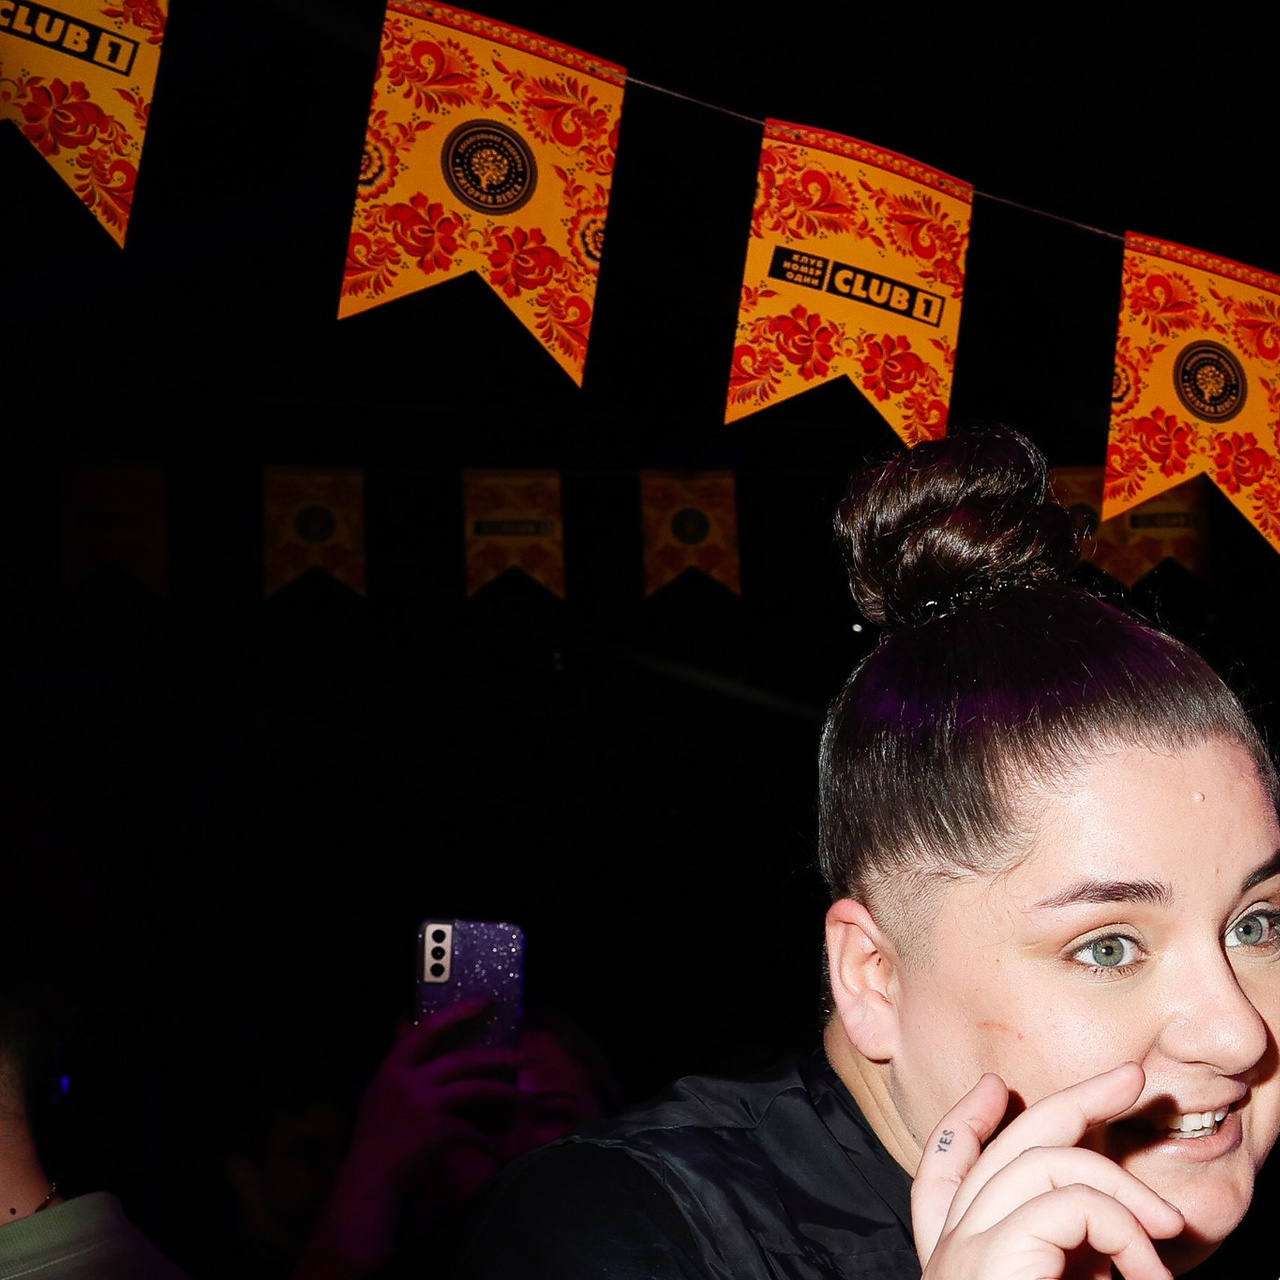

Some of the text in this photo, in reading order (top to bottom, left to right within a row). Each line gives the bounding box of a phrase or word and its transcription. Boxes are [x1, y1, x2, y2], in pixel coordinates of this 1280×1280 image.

[0, 0, 90, 53] CLUB
[791, 253, 825, 269] КЛУБ
[833, 268, 911, 312] CLUB
[935, 1129, 956, 1154] YES
